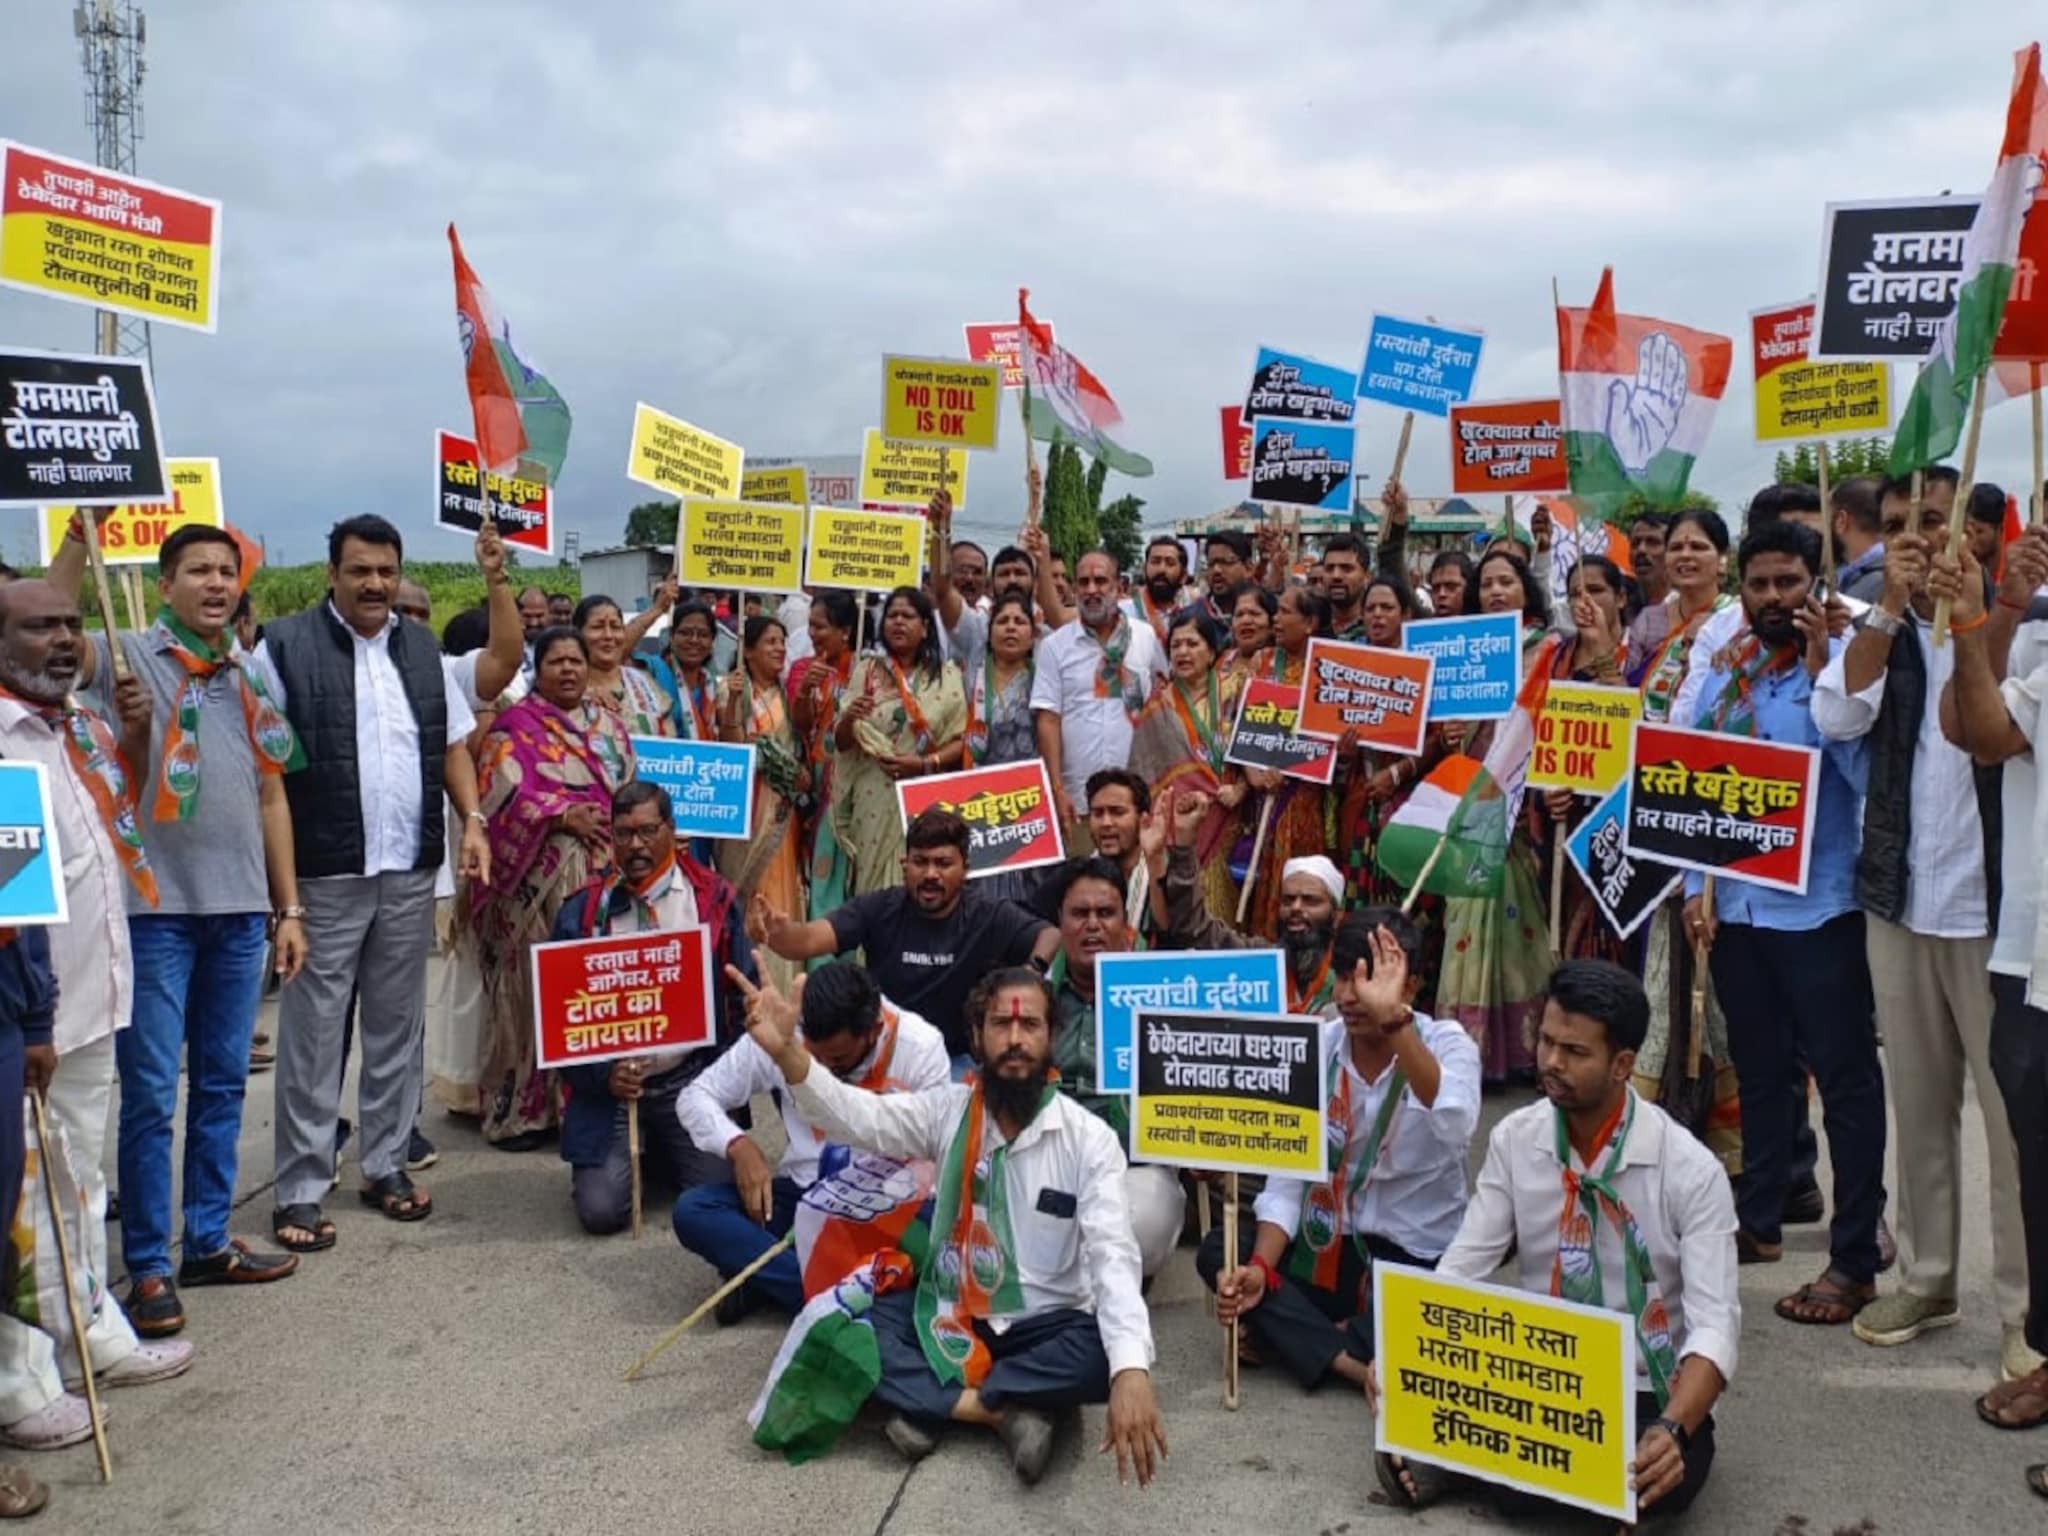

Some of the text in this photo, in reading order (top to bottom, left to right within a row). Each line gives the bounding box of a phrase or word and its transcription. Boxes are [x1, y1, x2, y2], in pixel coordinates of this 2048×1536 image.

[43, 170, 142, 210] तुपाशी आहेत
[18, 178, 163, 235] ठेकेदार आणि मंत्री
[110, 235, 142, 257] रस्ता
[148, 245, 195, 271] शोधत
[43, 259, 151, 301] टोलवसुलीची
[136, 262, 198, 292] खिशाला
[1864, 311, 1912, 341] नाही
[1269, 361, 1299, 381] टोल
[1416, 363, 1444, 385] टोल
[11, 375, 120, 415] मनमानी
[906, 385, 976, 412] NO TOLL
[1251, 386, 1285, 408] टोल
[1, 407, 141, 462] टोलवसुली
[917, 410, 965, 435] IS OK
[1267, 429, 1295, 451] टोल
[1464, 440, 1493, 465] टोल
[27, 457, 133, 484] नाही चालणार
[445, 460, 478, 487] रस्ते
[1255, 461, 1285, 483] टोल
[1321, 474, 1331, 493] ?
[444, 492, 462, 510] तर
[97, 520, 127, 549] IS
[1468, 631, 1511, 664] दुर्दशा
[1460, 660, 1487, 682] टोल
[1318, 681, 1349, 703] टोल
[1450, 681, 1509, 700] कशाला?
[1245, 700, 1277, 725] रस्ते
[1236, 731, 1330, 760] तर वाहने टोलमुक्त
[1536, 717, 1613, 750] O TOLL
[636, 753, 744, 786] स्त्यांची दुर्दशा
[1534, 745, 1596, 781] IS OK
[684, 781, 715, 801] टोल
[1640, 760, 1802, 817] रस्ते खड्डेयुक्त
[672, 801, 739, 821] कशाला?
[959, 785, 1041, 826] खड्डेयुक्त
[987, 817, 1047, 845] टोलमुक्त
[1635, 806, 1798, 854] तर वाहने टोलमुक्त
[584, 939, 682, 973] रस्ताच नाही
[656, 965, 681, 984] तर
[564, 986, 664, 1024] टोल का
[1107, 974, 1199, 1008] रस्त्यांची
[563, 1014, 669, 1053] द्यायचा?
[1147, 1022, 1242, 1060] ठेकेदाराच्या
[1163, 1054, 1231, 1088] टोलवाढ
[1233, 1061, 1292, 1095] दरवर्षी
[1153, 1101, 1300, 1130] प्रवाश्यांच्या पदरात मात्र
[1146, 1124, 1196, 1145] रस्त्यांची
[1200, 1130, 1241, 1150] चाळण
[1420, 1299, 1579, 1360] खड्ड्यांनी रस्ता
[1416, 1334, 1584, 1401] भरला सामडाम
[1399, 1366, 1605, 1445] प्रवाश्यांच्या माथी
[1431, 1404, 1573, 1474] ट्रॅफिक जाम
